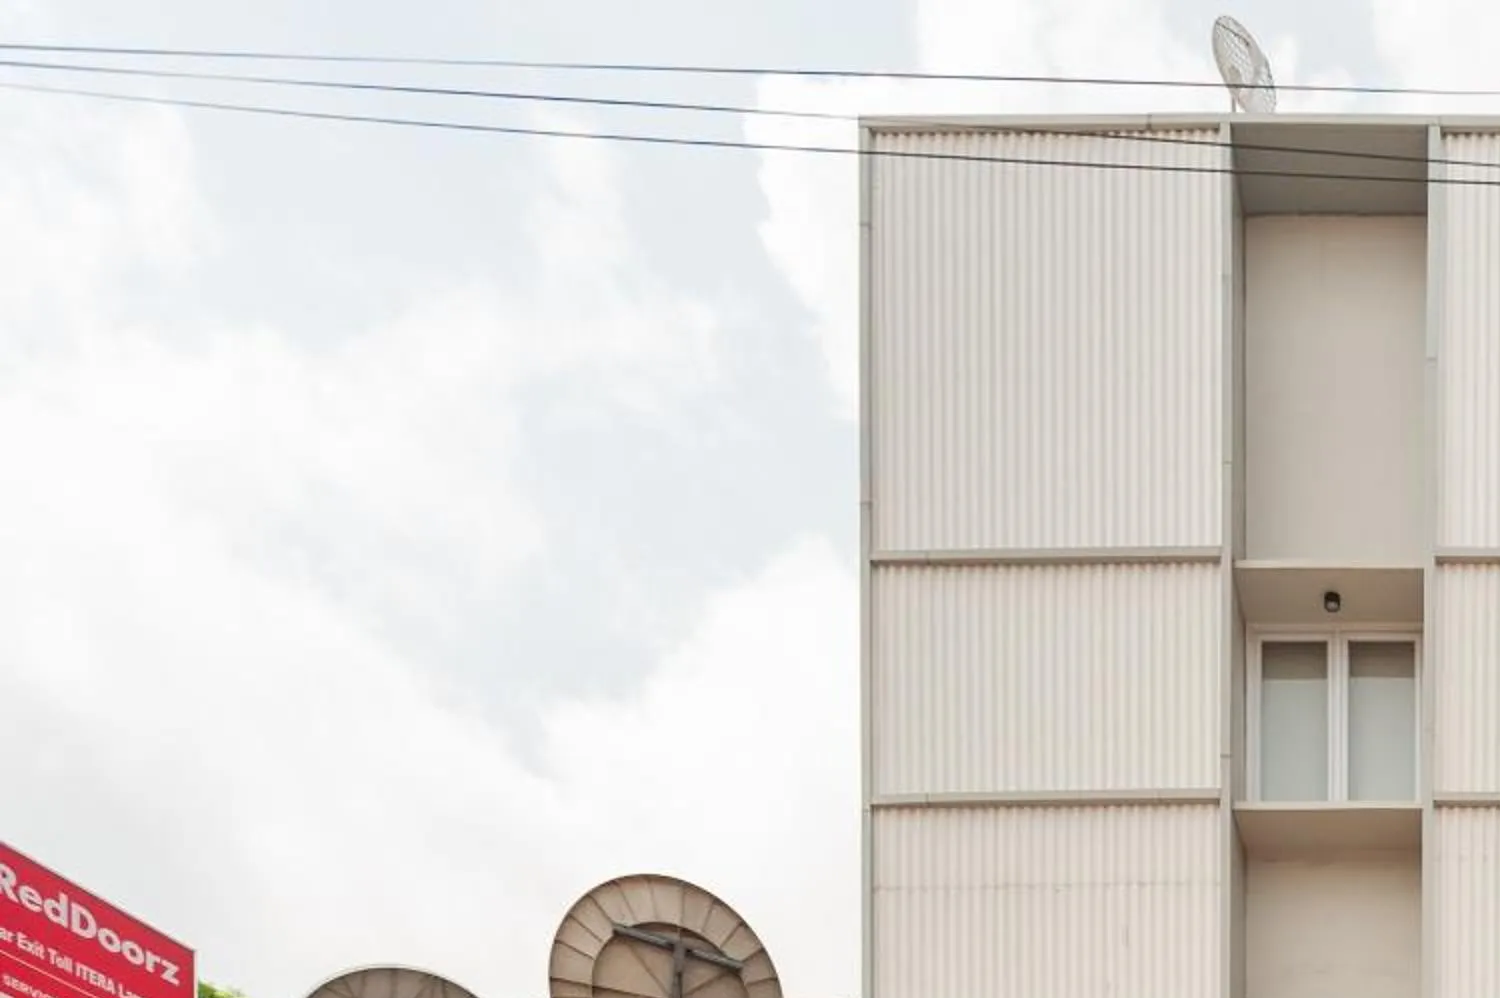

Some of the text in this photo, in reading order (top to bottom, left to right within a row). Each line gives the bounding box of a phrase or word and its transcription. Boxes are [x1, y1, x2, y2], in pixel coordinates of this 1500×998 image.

[0, 862, 181, 986] RedDoorz
[16, 931, 46, 960] Exit
[47, 947, 74, 974] Toll
[75, 961, 117, 995] ITERA
